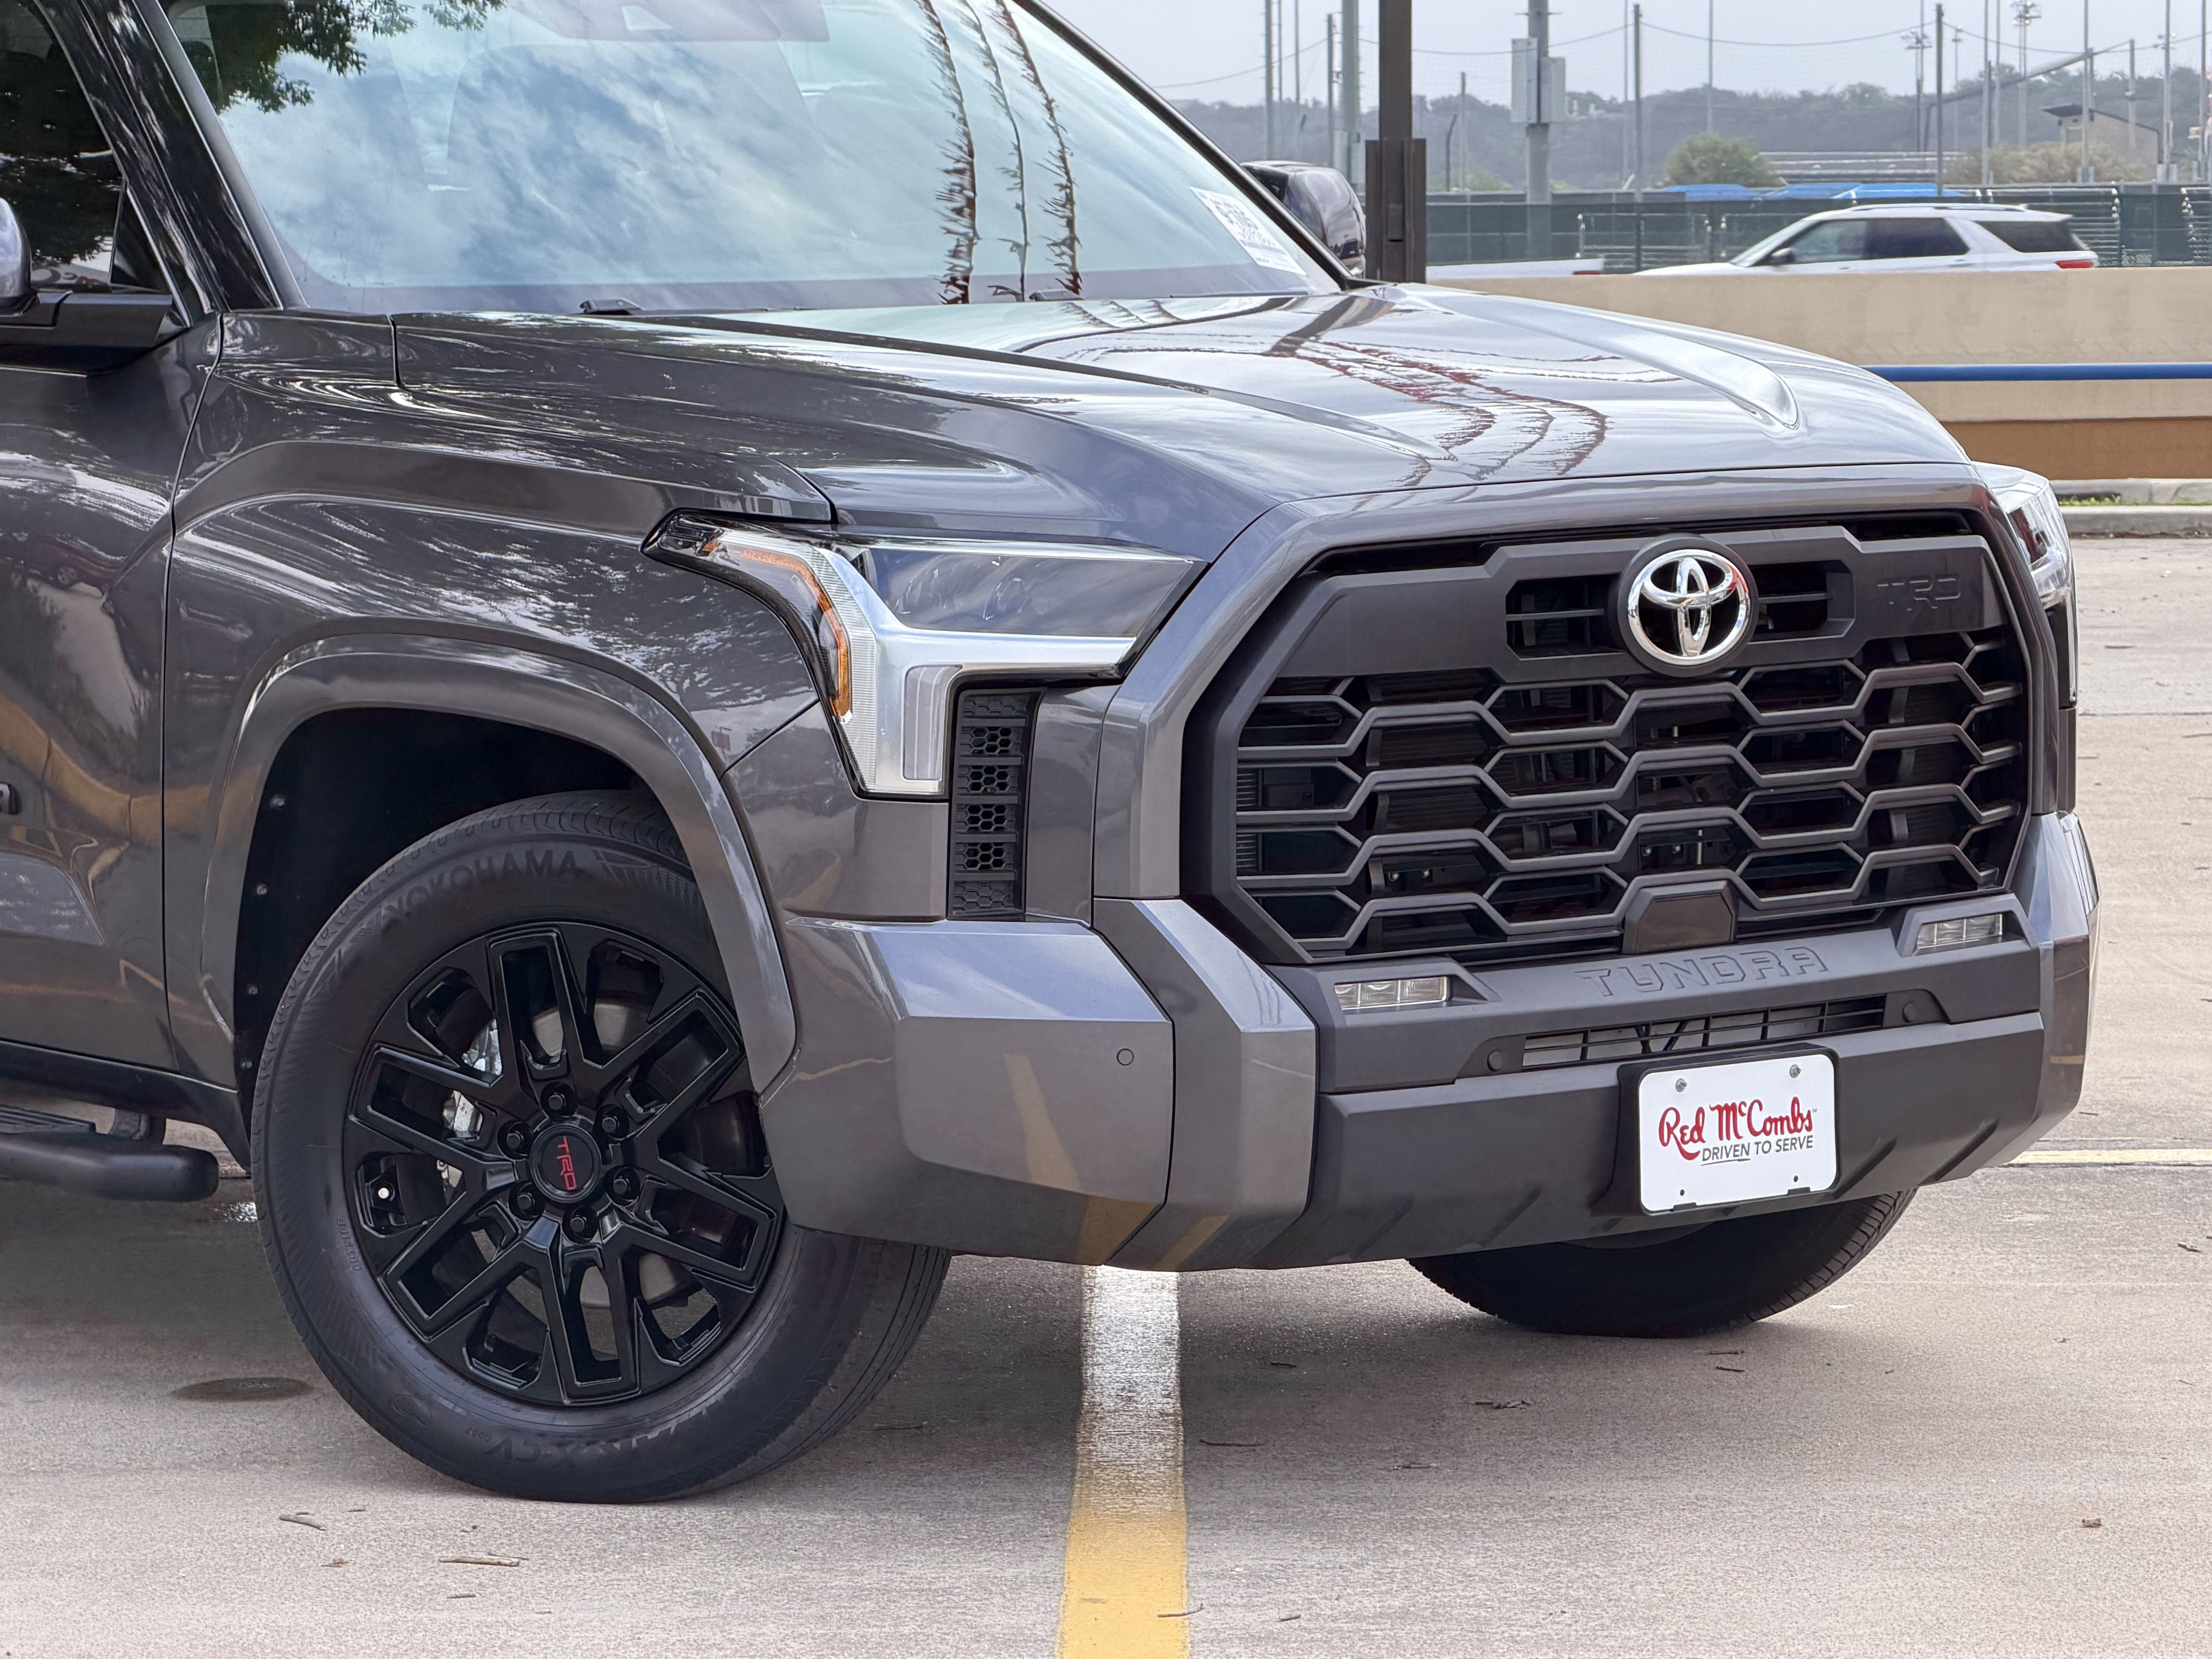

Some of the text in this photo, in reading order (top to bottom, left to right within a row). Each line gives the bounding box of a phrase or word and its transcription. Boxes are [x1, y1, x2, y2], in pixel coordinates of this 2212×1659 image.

[1876, 573, 1962, 611] TRD
[386, 850, 581, 921] YOKOHAMA
[1574, 946, 1829, 997] TUNDRA
[1658, 1097, 1813, 1161] Red McCombs
[1702, 1135, 1814, 1161] DRIVEN TO SERVE
[556, 1135, 577, 1191] TRD
[337, 1218, 362, 1271] OUTSIDE
